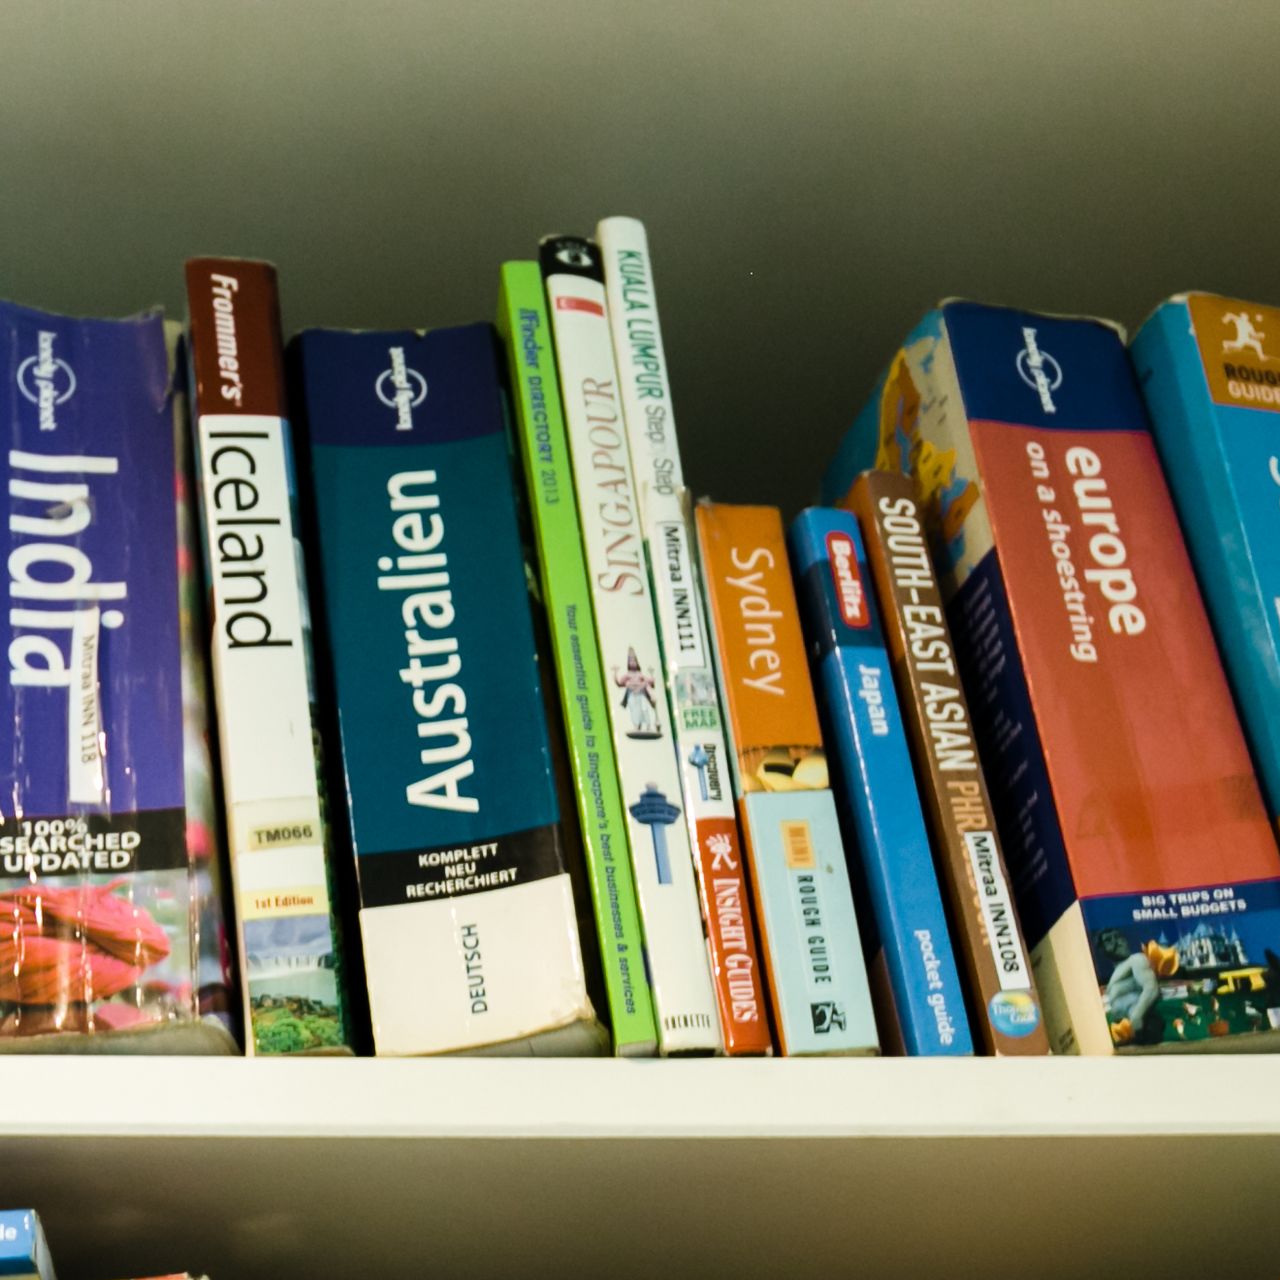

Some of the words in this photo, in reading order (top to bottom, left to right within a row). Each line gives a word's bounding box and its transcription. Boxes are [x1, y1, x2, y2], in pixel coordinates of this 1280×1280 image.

[618, 249, 645, 312] KUALA
[626, 317, 664, 399] LUMPUR
[582, 377, 643, 598] SINGAPOUR
[1026, 441, 1050, 479] on
[1038, 485, 1057, 505] a
[8, 450, 127, 688] India
[208, 430, 293, 649] Iceland
[1065, 446, 1147, 636] europe
[829, 539, 862, 620] Berlitz
[1043, 508, 1099, 664] shoestring
[377, 469, 480, 813] Australien
[725, 547, 785, 695] Sydney
[859, 663, 889, 737] Japan
[254, 824, 313, 845] TM066
[418, 843, 498, 866] KOMPLETT
[445, 861, 476, 876] NEU
[406, 867, 518, 898] RECHERCHIERT
[713, 877, 750, 950] INSIGHT
[795, 873, 818, 928] ROUGH
[1133, 906, 1177, 922] SMALL
[1181, 899, 1247, 918] BUDGETS
[1142, 894, 1165, 909] BIG
[1169, 891, 1209, 906] TRIPS
[1213, 888, 1235, 901] ON
[460, 923, 488, 1014] DEUTSCH
[722, 953, 758, 1023] GUIDES
[804, 934, 833, 987] GUIDE
